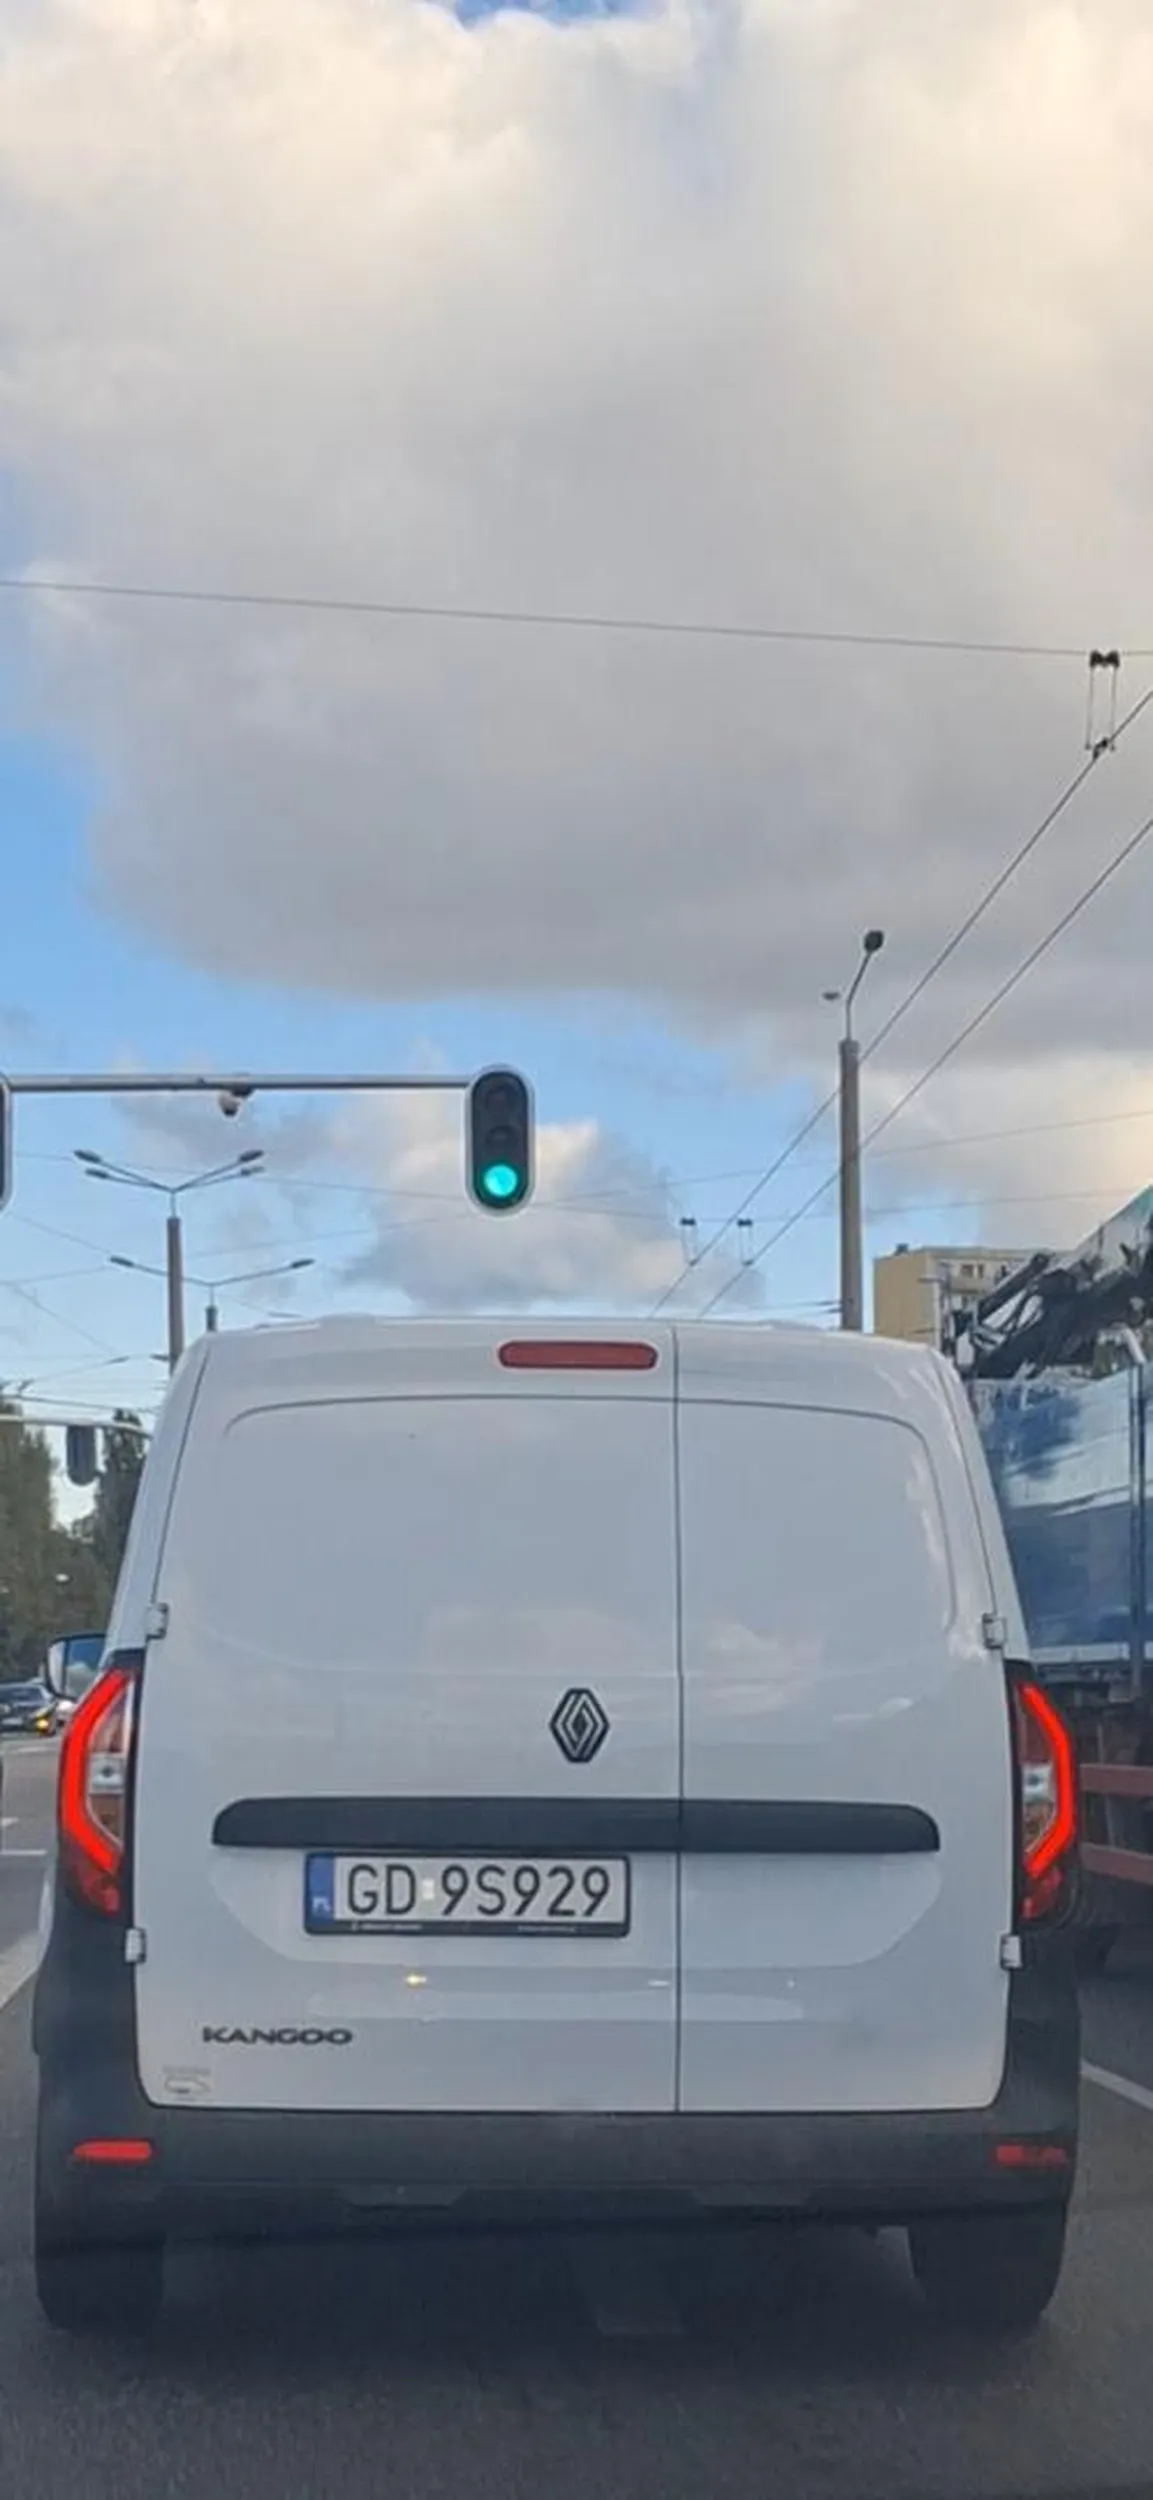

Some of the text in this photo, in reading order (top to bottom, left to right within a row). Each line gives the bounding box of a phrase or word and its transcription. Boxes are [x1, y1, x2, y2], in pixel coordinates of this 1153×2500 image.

[347, 1863, 611, 1917] GD 9S929
[202, 2026, 353, 2045] KANGOO
